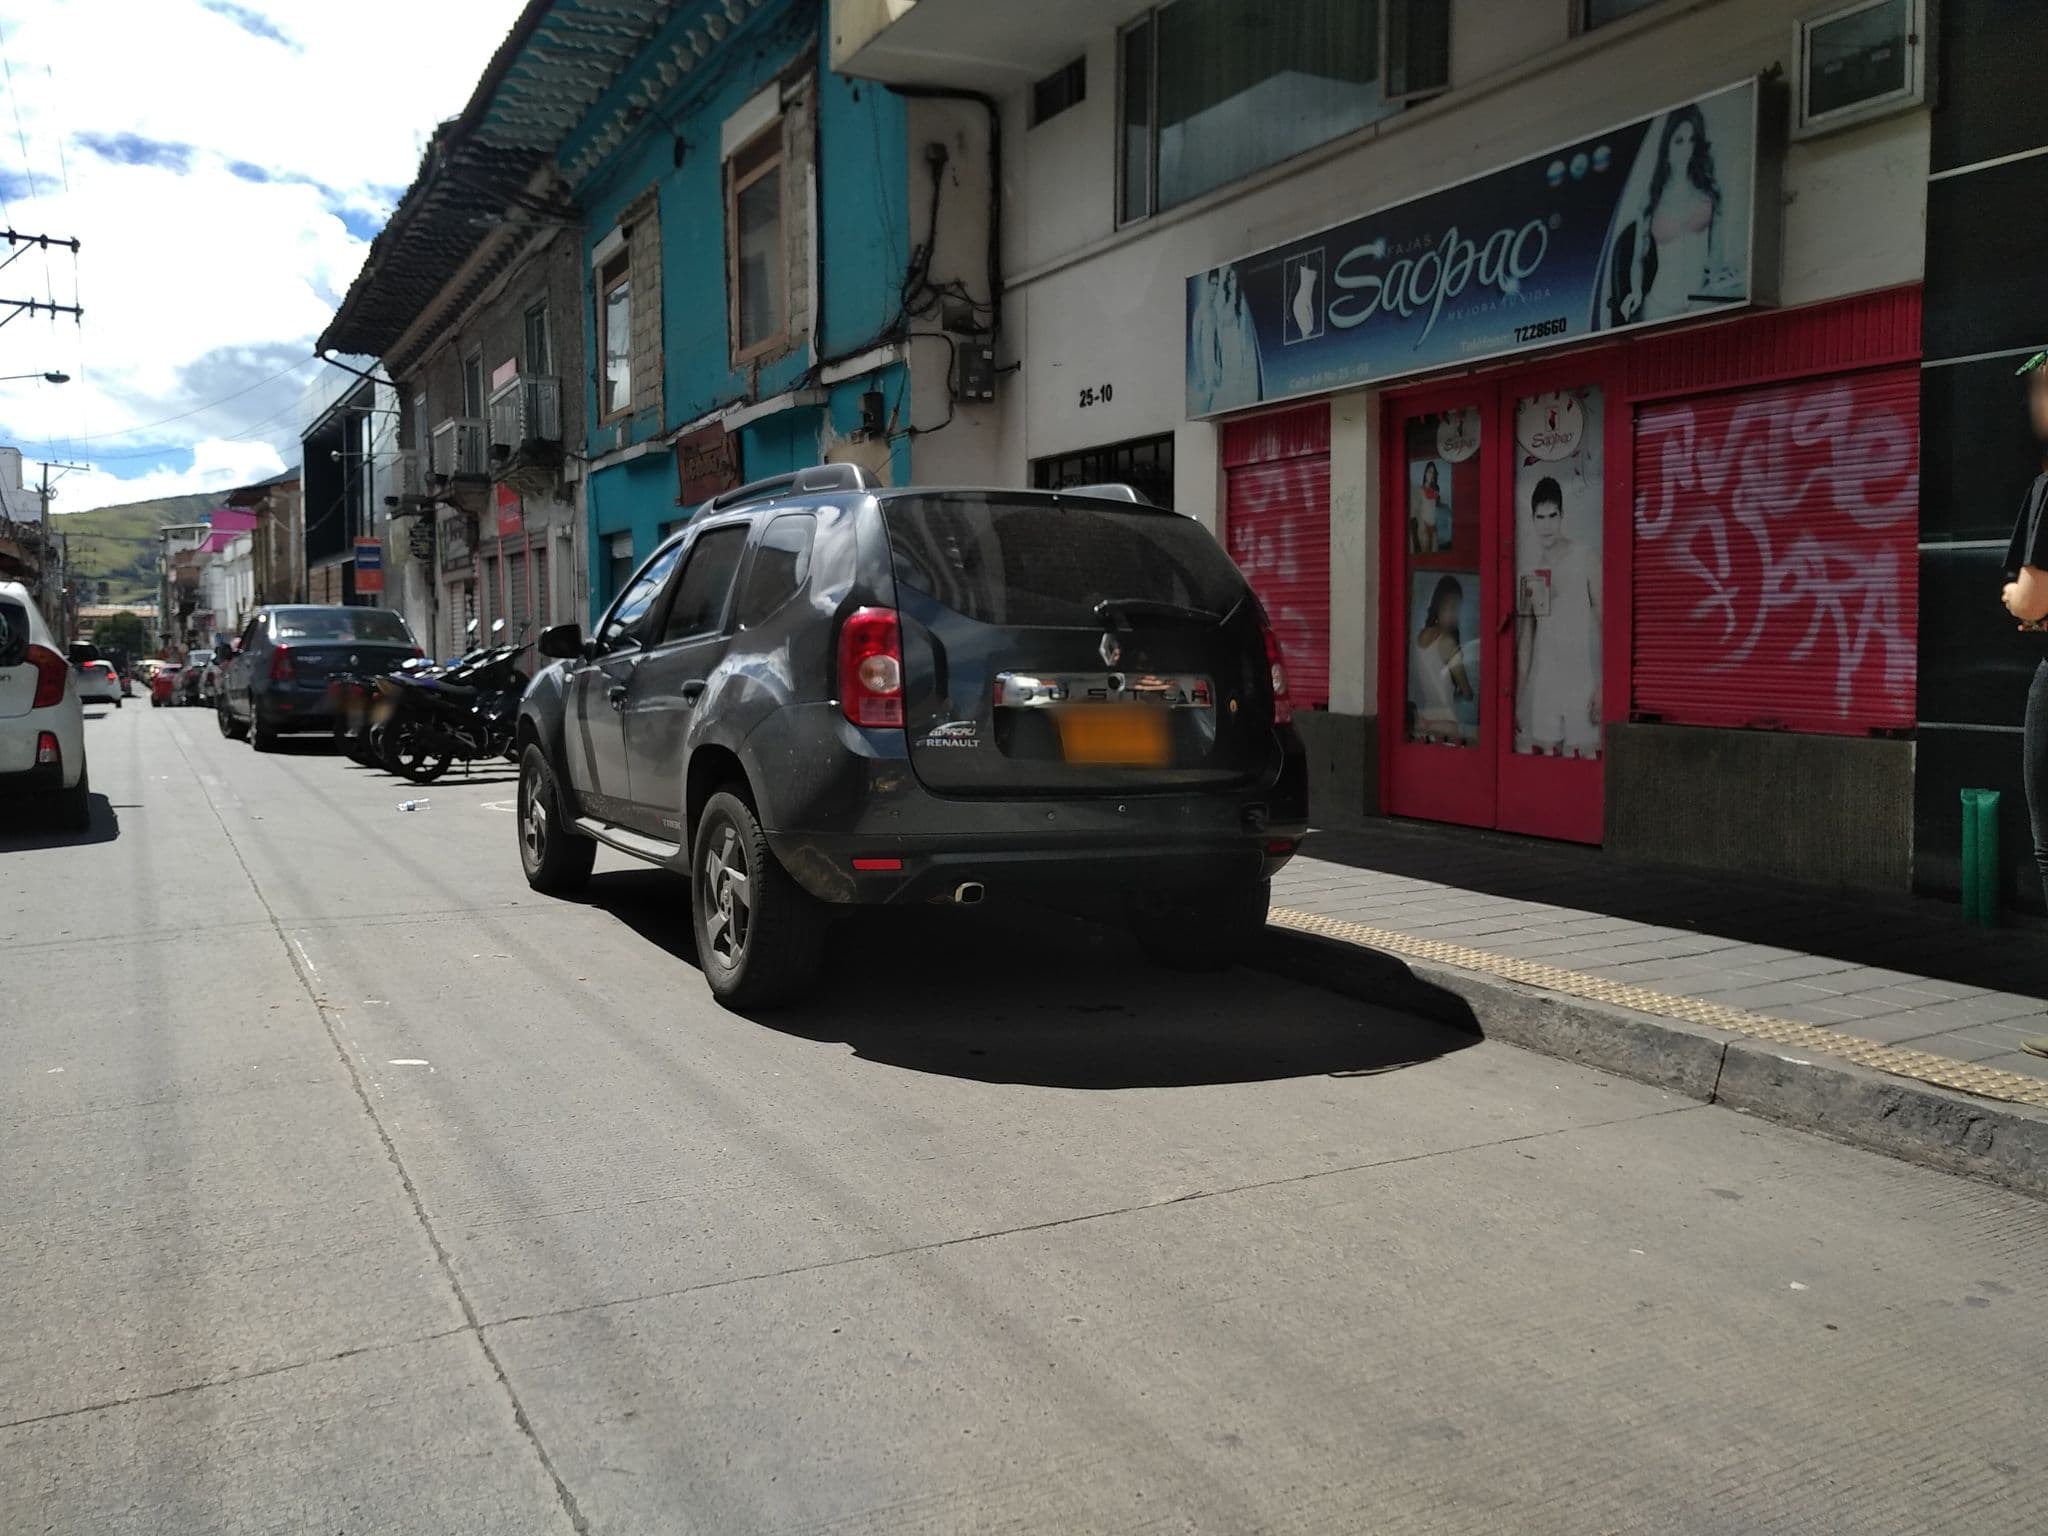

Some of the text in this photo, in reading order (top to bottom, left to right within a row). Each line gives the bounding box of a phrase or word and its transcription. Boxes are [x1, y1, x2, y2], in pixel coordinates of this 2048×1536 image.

[1328, 218, 1549, 350] Saopao
[1447, 301, 1497, 321] MEJORA
[1514, 317, 1567, 343] 7228660
[1079, 383, 1113, 408] 25-10
[925, 738, 981, 748] RENAULT
